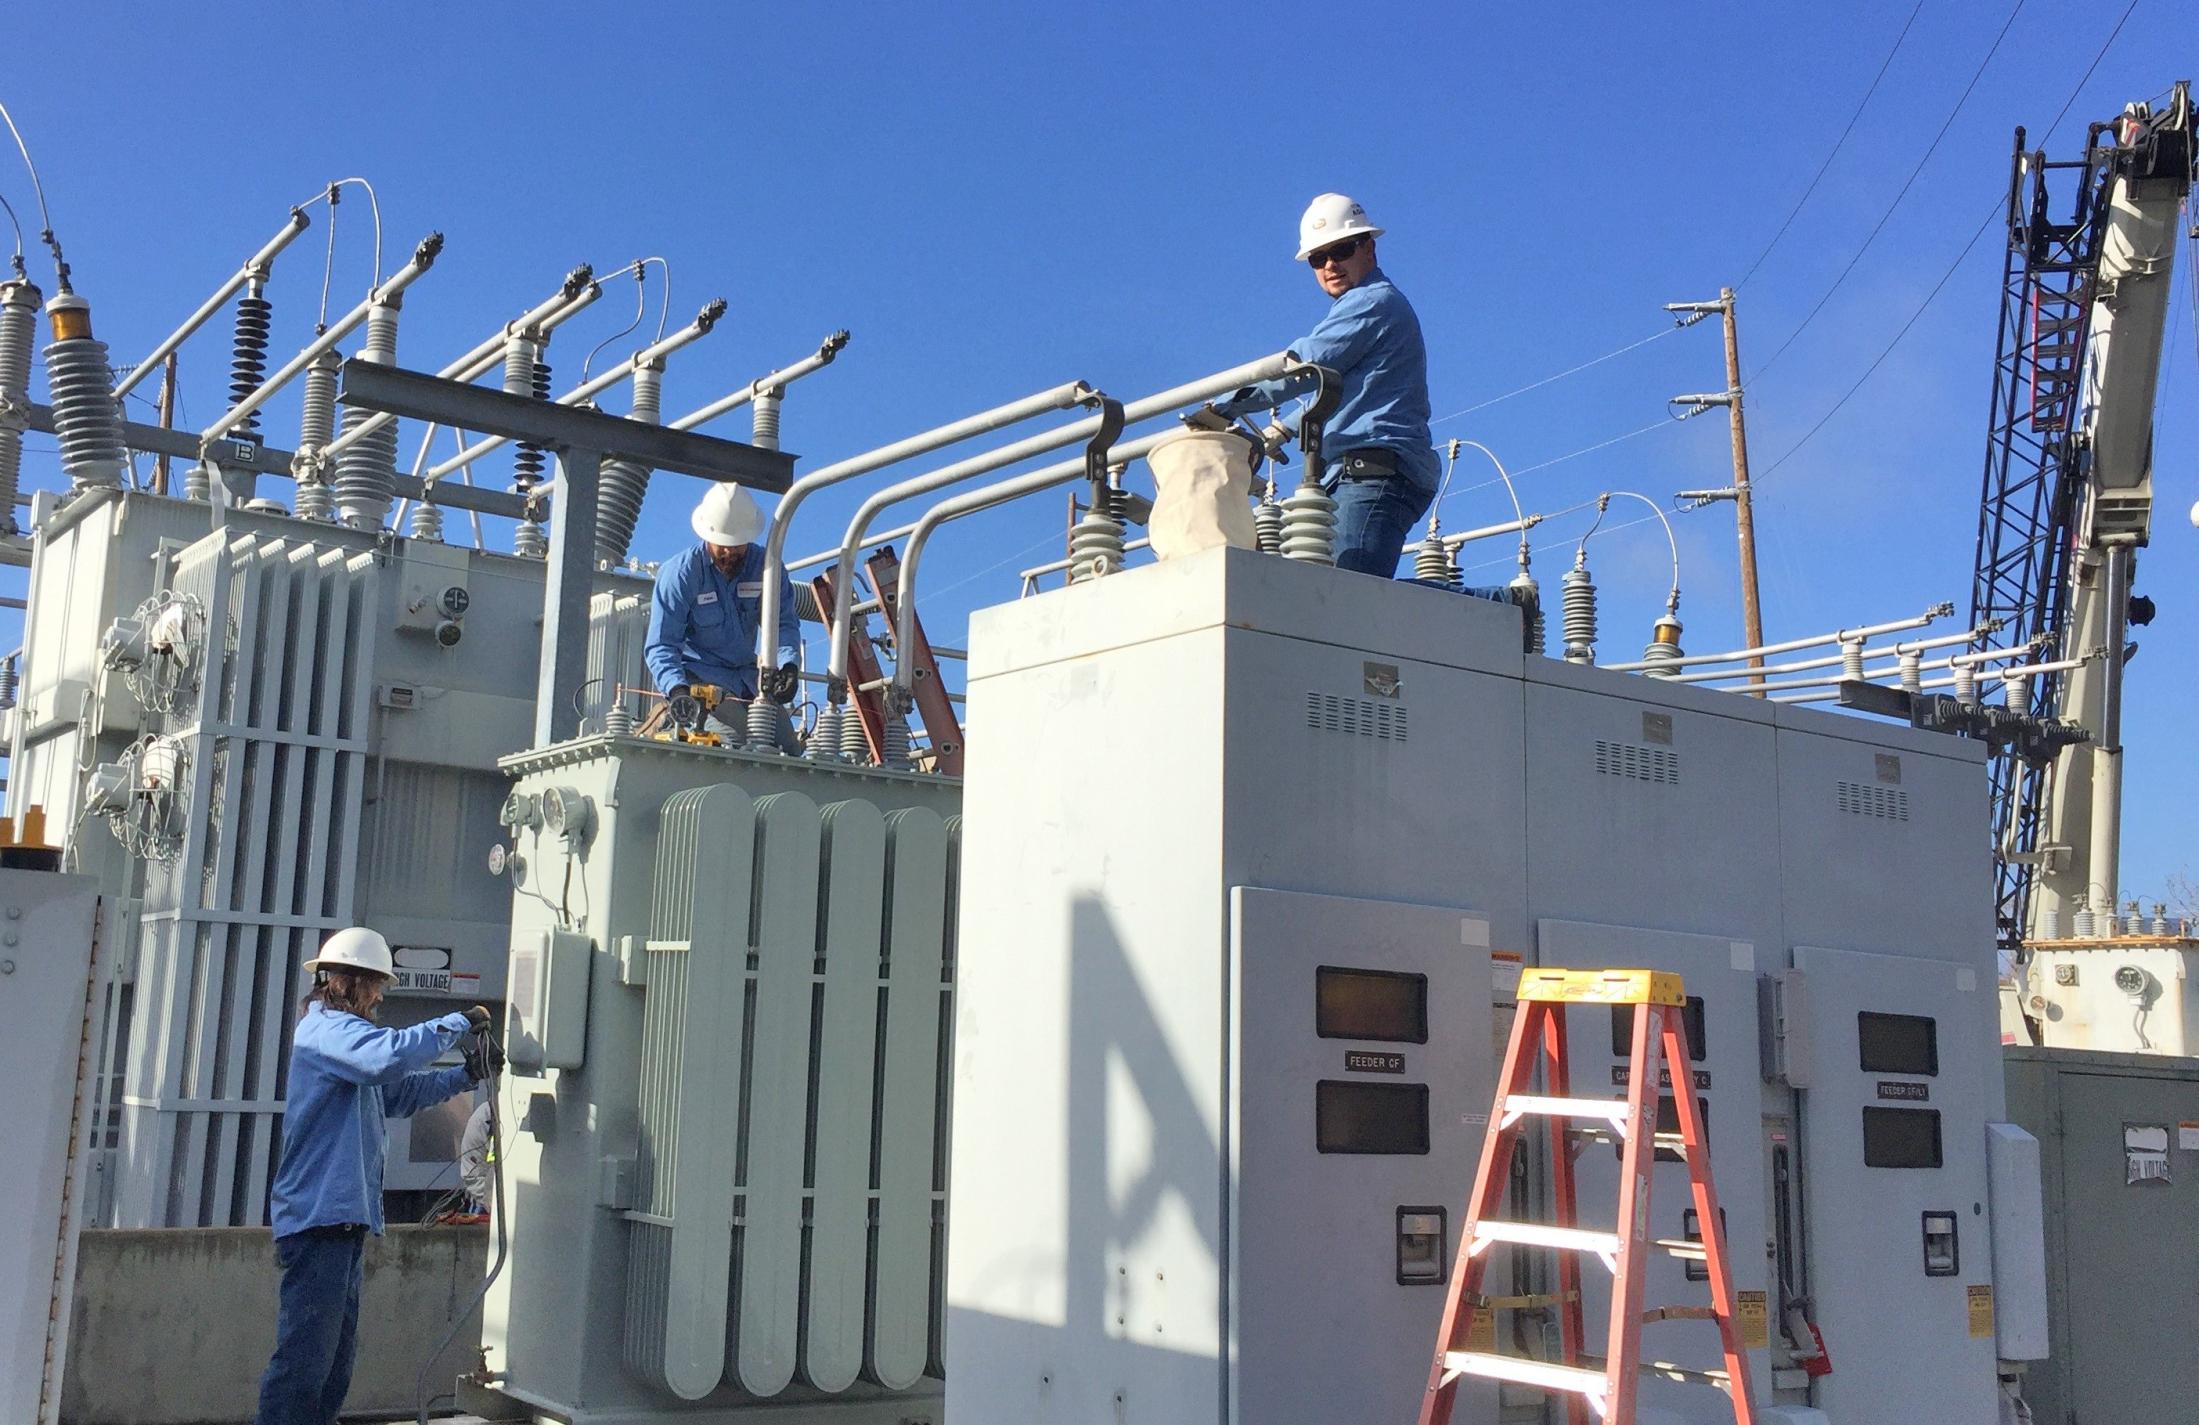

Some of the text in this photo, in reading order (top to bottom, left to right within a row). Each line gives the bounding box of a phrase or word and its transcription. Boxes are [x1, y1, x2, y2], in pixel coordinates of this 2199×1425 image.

[238, 444, 253, 459] B
[414, 973, 449, 989] VOLTAGE
[1350, 1055, 1400, 1068] FEEDER CF
[1881, 1085, 1906, 1096] FEEDER
